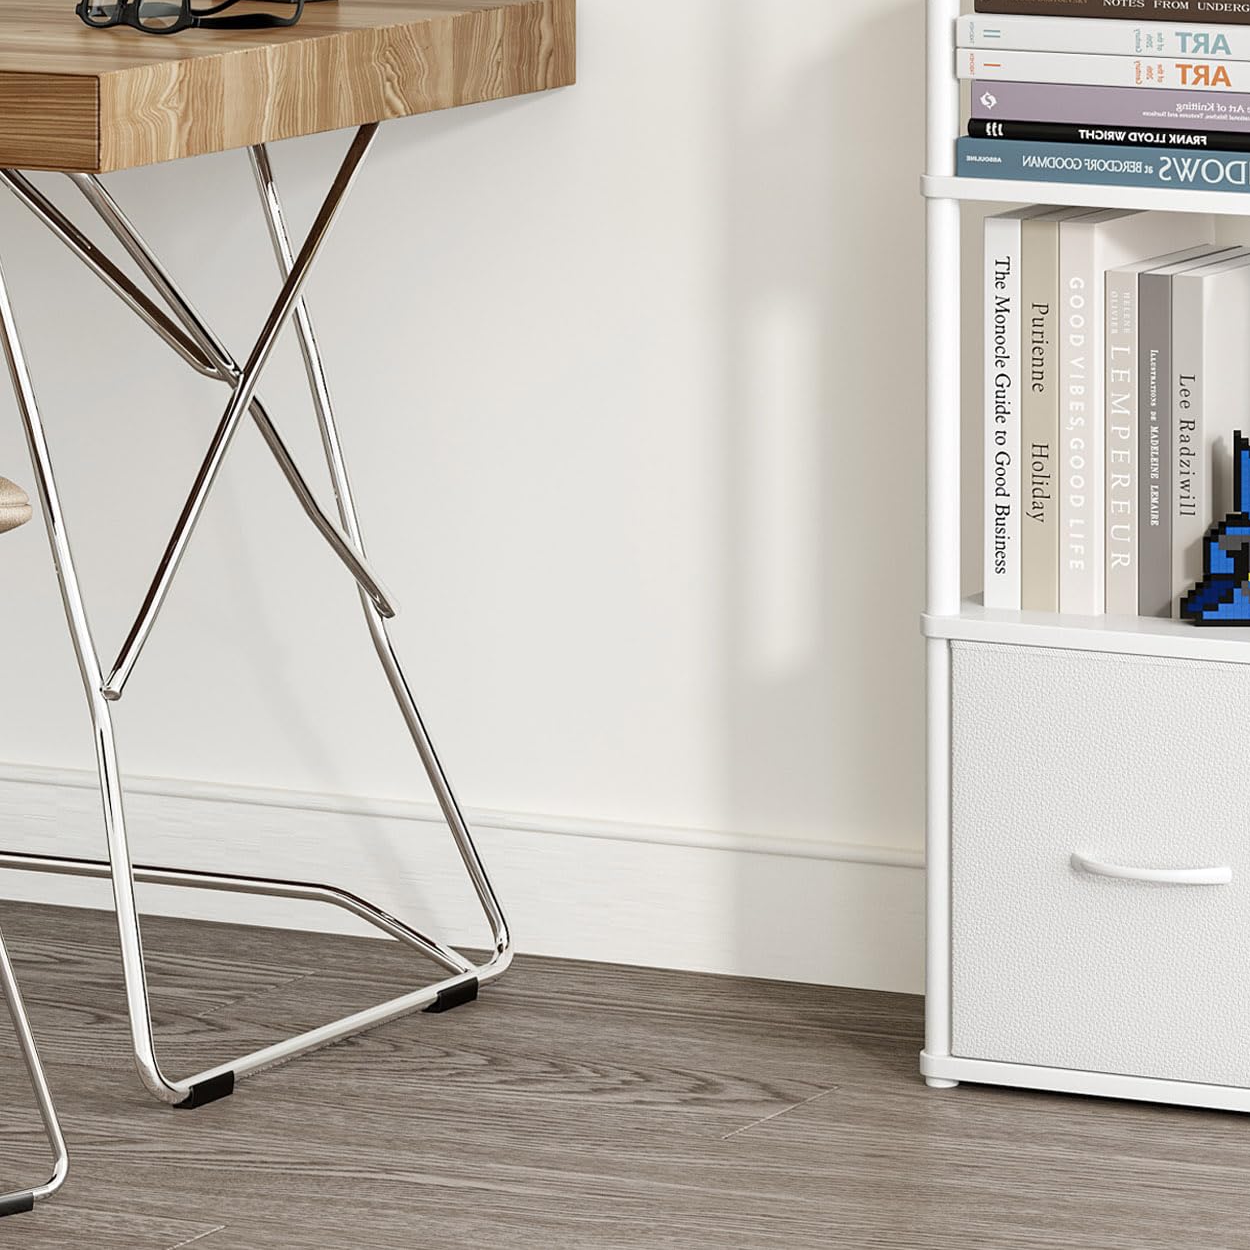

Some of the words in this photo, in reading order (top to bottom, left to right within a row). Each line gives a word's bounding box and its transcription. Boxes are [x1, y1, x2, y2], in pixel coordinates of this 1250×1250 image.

[1153, 0, 1189, 10] FROM
[994, 255, 1012, 290] The
[994, 294, 1012, 369] Monocle
[1068, 276, 1085, 348] GOOD
[1110, 290, 1119, 335] OLIVIER
[1031, 302, 1050, 394] Purienne
[994, 372, 1012, 424] Guide
[1065, 356, 1085, 432] VIBES,
[1178, 374, 1196, 410] Lee
[994, 430, 1009, 446] to
[1110, 345, 1131, 570] LEMPEREUR
[1149, 425, 1159, 479] MADELEINE
[994, 450, 1012, 498] Good
[1025, 442, 1051, 524] Holiday
[1068, 437, 1085, 508] GOOD
[1178, 419, 1196, 517] Radziwill
[1149, 485, 1159, 526] LEMAIRE
[994, 503, 1012, 575] Business
[1068, 518, 1085, 571] LIFE
